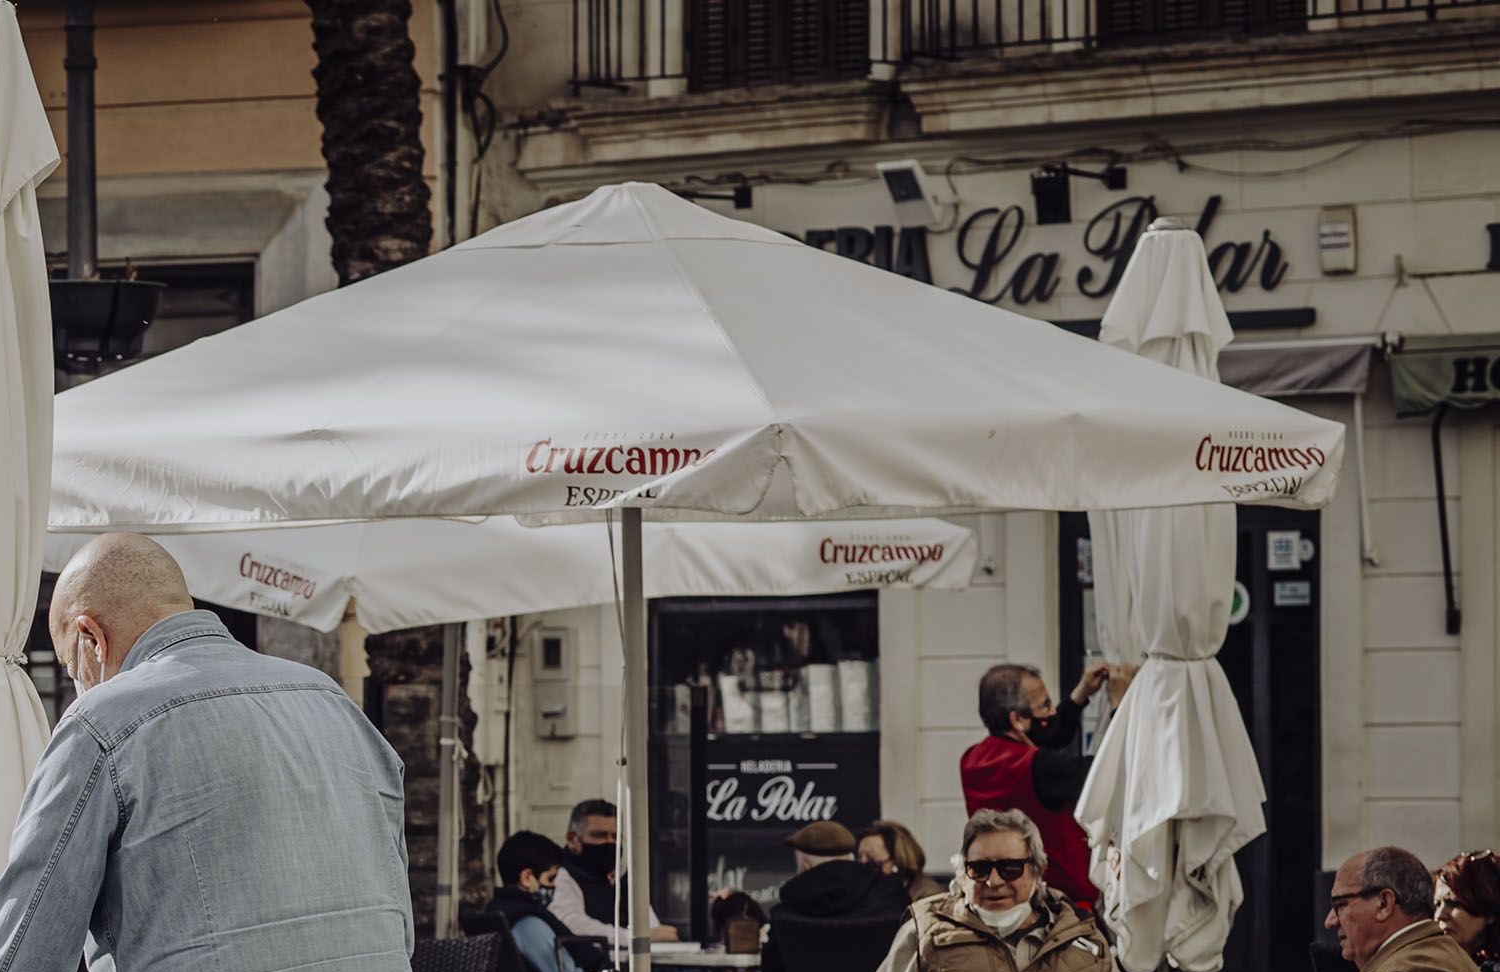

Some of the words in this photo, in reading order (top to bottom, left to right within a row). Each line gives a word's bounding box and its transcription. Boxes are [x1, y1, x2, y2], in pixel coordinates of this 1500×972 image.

[952, 205, 1060, 303] La
[1195, 433, 1326, 471] Cruzcampo
[819, 537, 944, 565] Cruzcampo
[706, 776, 748, 821] La
[751, 775, 838, 821] Polar
